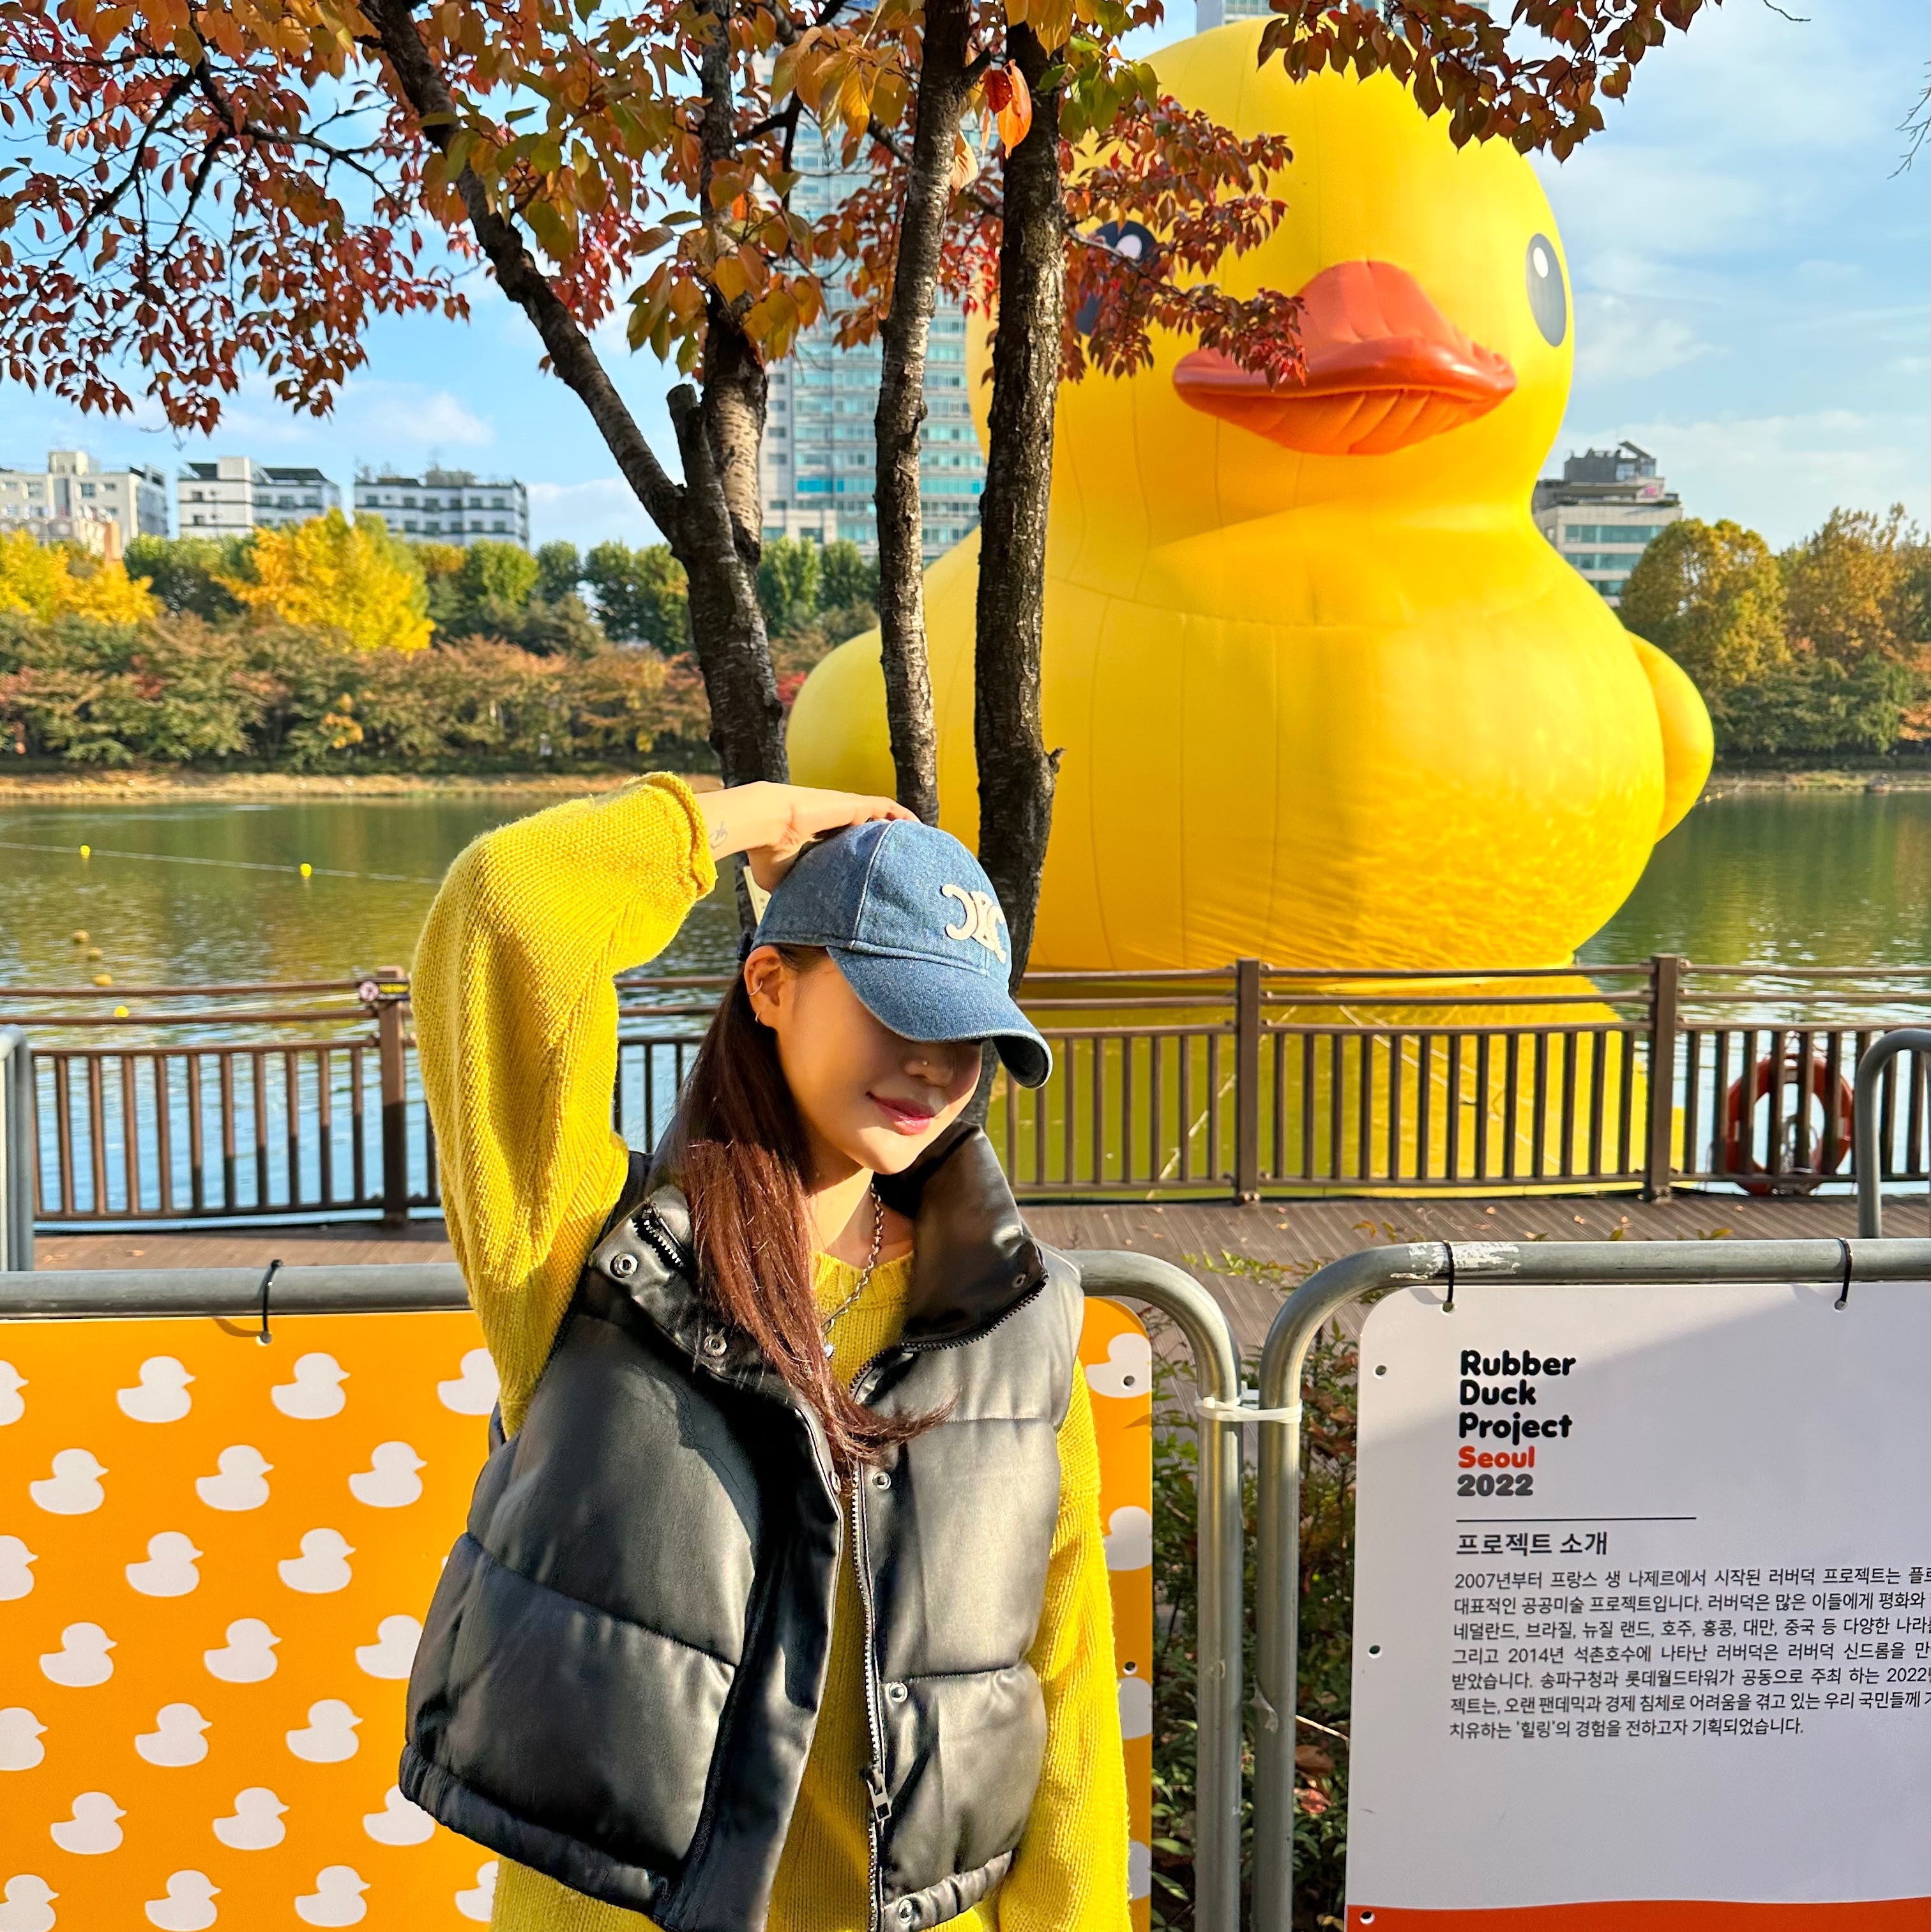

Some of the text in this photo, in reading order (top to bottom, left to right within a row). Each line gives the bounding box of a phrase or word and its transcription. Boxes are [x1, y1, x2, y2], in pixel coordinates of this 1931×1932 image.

[1460, 1350, 1576, 1376] Rubber
[1460, 1379, 1536, 1406] Duck
[1459, 1411, 1573, 1446] Project
[1458, 1445, 1535, 1469] Seoul
[1457, 1473, 1533, 1496] 2022
[1456, 1532, 1607, 1556] 프로젝트 소개
[1455, 1571, 1542, 1590] 2007년부터
[1550, 1571, 1597, 1589] 프랑스
[1605, 1571, 1620, 1588] 생
[1629, 1569, 1706, 1587] 나제르에서
[1715, 1569, 1761, 1586] 시작된
[1769, 1568, 1815, 1586] 러버덕
[1822, 1567, 1901, 1585] 프로젝트는
[1455, 1597, 1516, 1615] 대표적인
[1522, 1596, 1584, 1615] 공공미술
[1589, 1595, 1702, 1613] 프로젝트입니다.
[1708, 1594, 1770, 1612] 러버덕은
[1775, 1593, 1806, 1612] 많은
[1812, 1592, 1874, 1611] 이들에게
[1877, 1591, 1927, 1611] 평화와
[1454, 1616, 1931, 1641] 네덜란드, 브라질, 뉴질 랜드, 호주, 홍콩, 대만, 중국 등 다양한 나라
[1452, 1647, 1499, 1665] 그리고
[1508, 1647, 1563, 1664] 2014년
[1574, 1645, 1651, 1664] 석촌호수에
[1662, 1644, 1708, 1662] 나타난
[1716, 1643, 1779, 1662] 러버덕은
[1788, 1643, 1834, 1661] 러버덕
[1843, 1642, 1907, 1661] 신드롬을
[1452, 1666, 1931, 1691] 받았습니다. 송파구청과 롯데월드타워가 공동으로 주최 하는 2022
[1504, 1696, 1535, 1714] 오랜
[1539, 1695, 1602, 1714] 팬데믹과
[1605, 1694, 1635, 1713] 경제
[1639, 1694, 1686, 1712] 침체로
[1690, 1693, 1752, 1712] 어려움을
[1755, 1693, 1786, 1710] 겪고
[1791, 1692, 1821, 1710] 있는
[1824, 1691, 1854, 1710] 우리
[1858, 1691, 1921, 1709] 국민들께
[1450, 1721, 1511, 1739] 치유하는
[1575, 1720, 1622, 1737] 경험을
[1626, 1719, 1688, 1737] 전하고자
[1692, 1717, 1803, 1737] 기획되었습니다.
